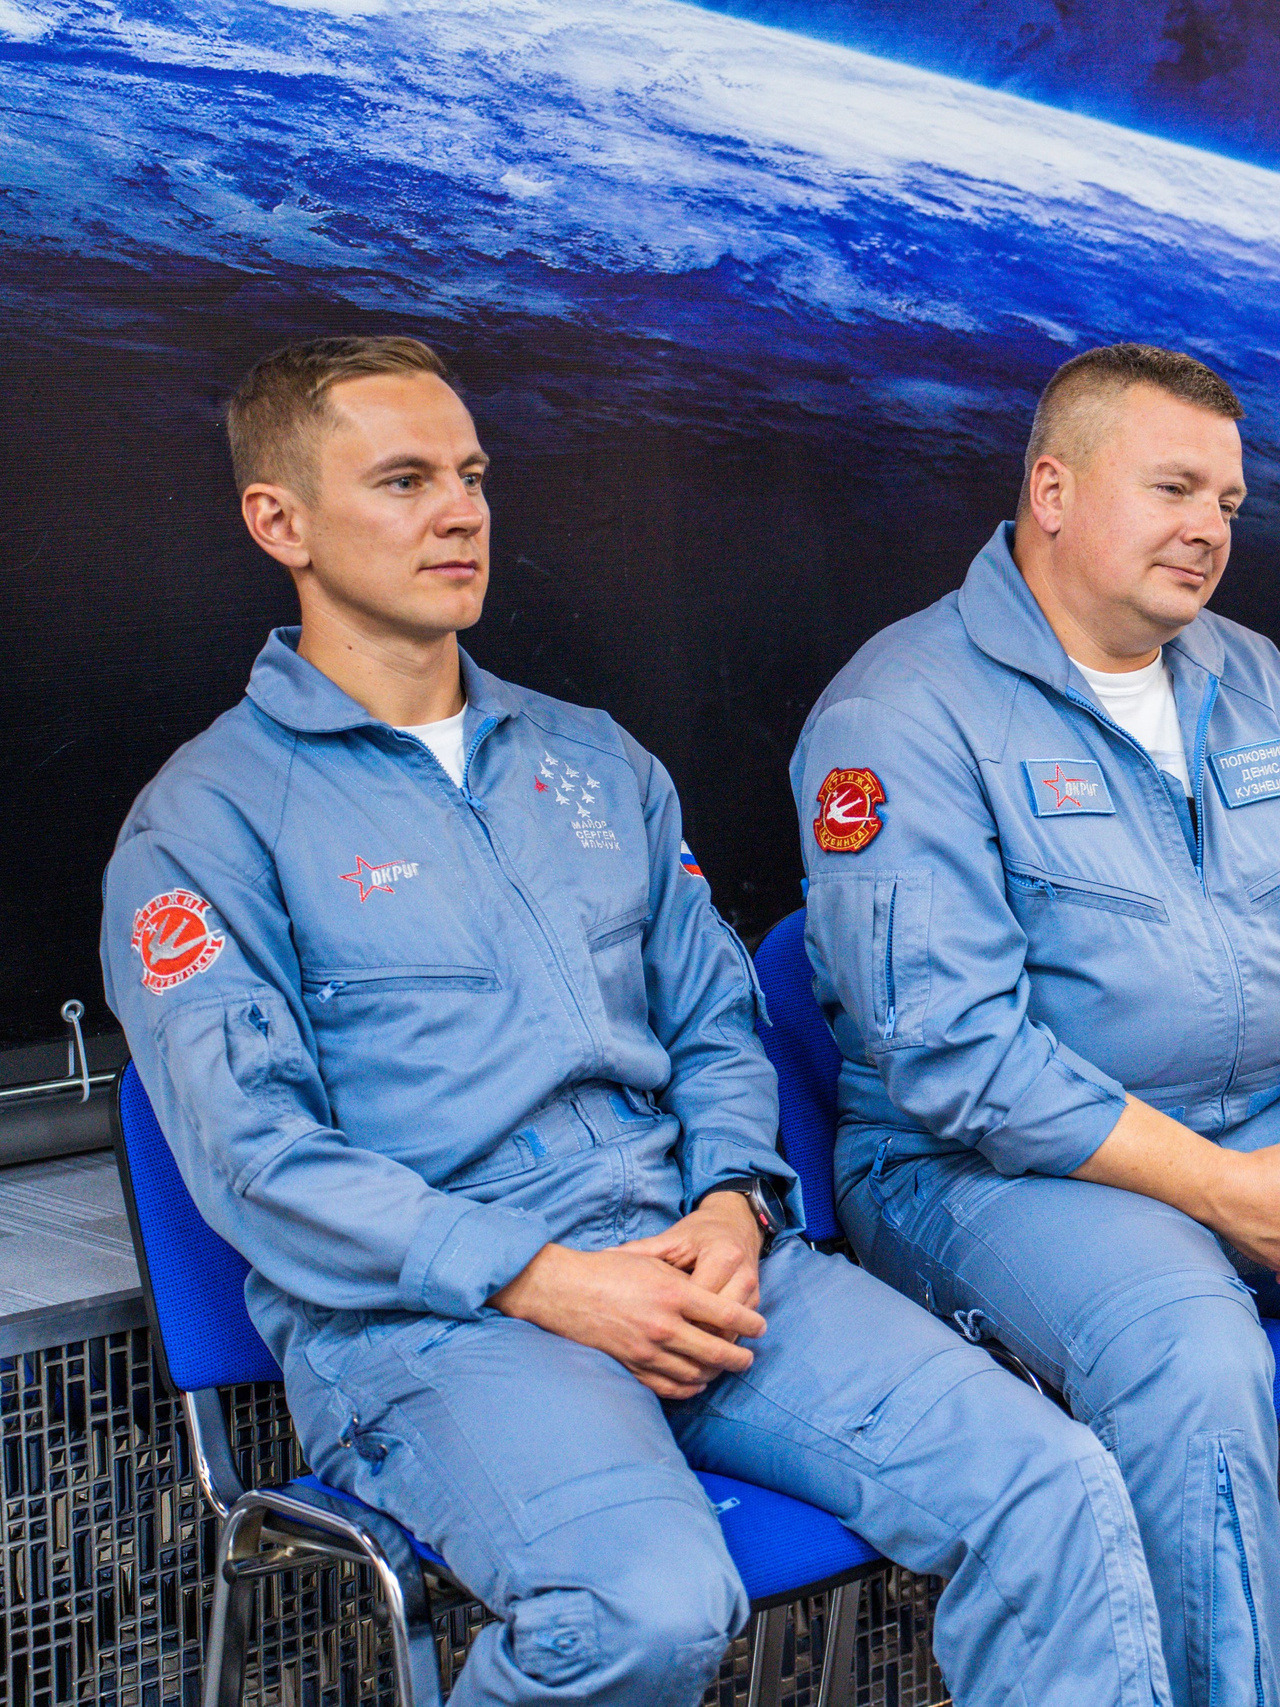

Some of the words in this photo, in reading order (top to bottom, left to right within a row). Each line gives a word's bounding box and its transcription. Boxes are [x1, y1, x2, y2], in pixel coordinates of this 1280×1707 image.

[1242, 762, 1280, 783] ДЕНИС
[828, 773, 872, 792] СТРИЖИ
[1065, 782, 1098, 797] ОКРУГ
[571, 819, 607, 830] МАЙОР
[576, 830, 616, 841] СЕРГЕЙ
[821, 830, 864, 847] КУБИНКА
[581, 839, 621, 851] ИЛЬЧУК
[371, 862, 419, 886] ОКРУГ
